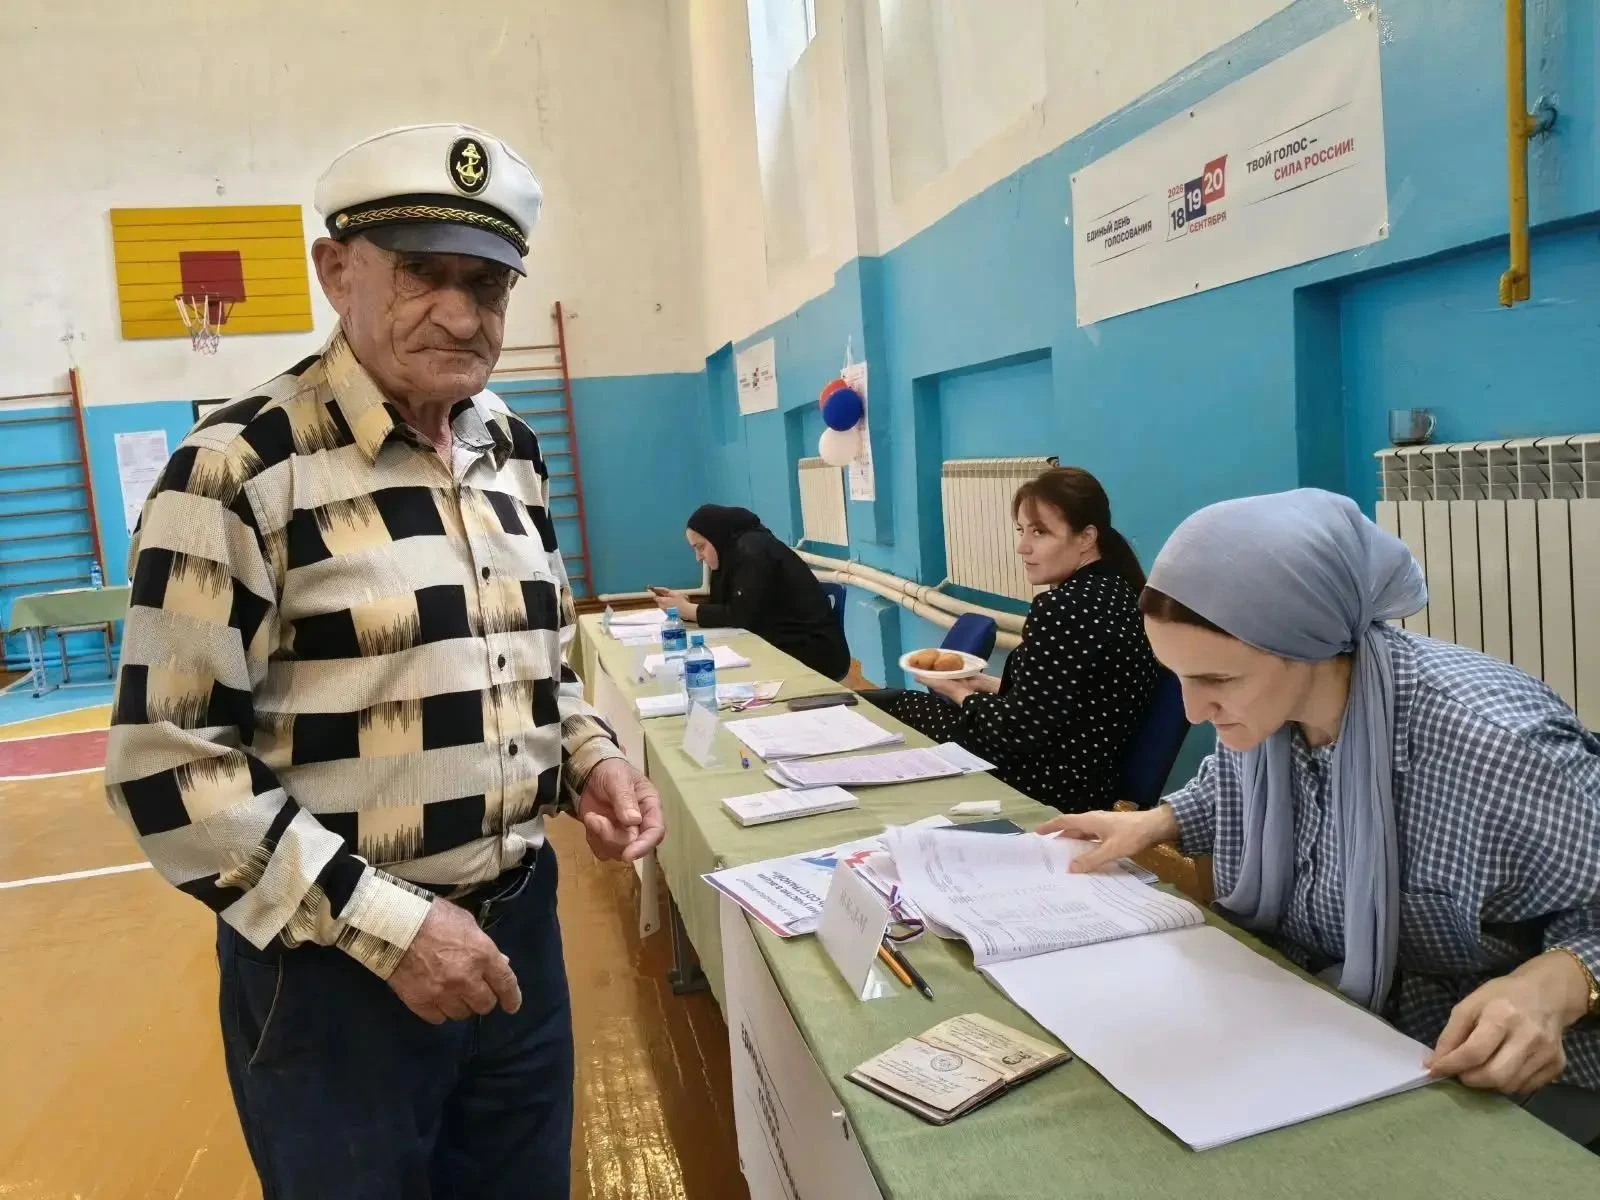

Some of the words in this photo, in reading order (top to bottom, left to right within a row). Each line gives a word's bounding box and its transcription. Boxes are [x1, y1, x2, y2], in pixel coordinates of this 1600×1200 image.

[1246, 151, 1272, 174] ТВОЙ
[1273, 137, 1308, 163] ГОЛОС
[1274, 160, 1302, 181] СИЛА
[1304, 137, 1354, 169] РОССИИ!
[1167, 183, 1184, 198] 2026
[1171, 207, 1185, 231] 18
[1187, 188, 1202, 212] 19
[1203, 168, 1223, 195] 20
[1086, 220, 1113, 243] ЕДИНЫЙ
[1113, 216, 1131, 235] ДЕНЬ
[1104, 220, 1152, 249] ГОЛОСОВАНИЯ
[1189, 210, 1227, 234] СЕНТЯБРЯ
